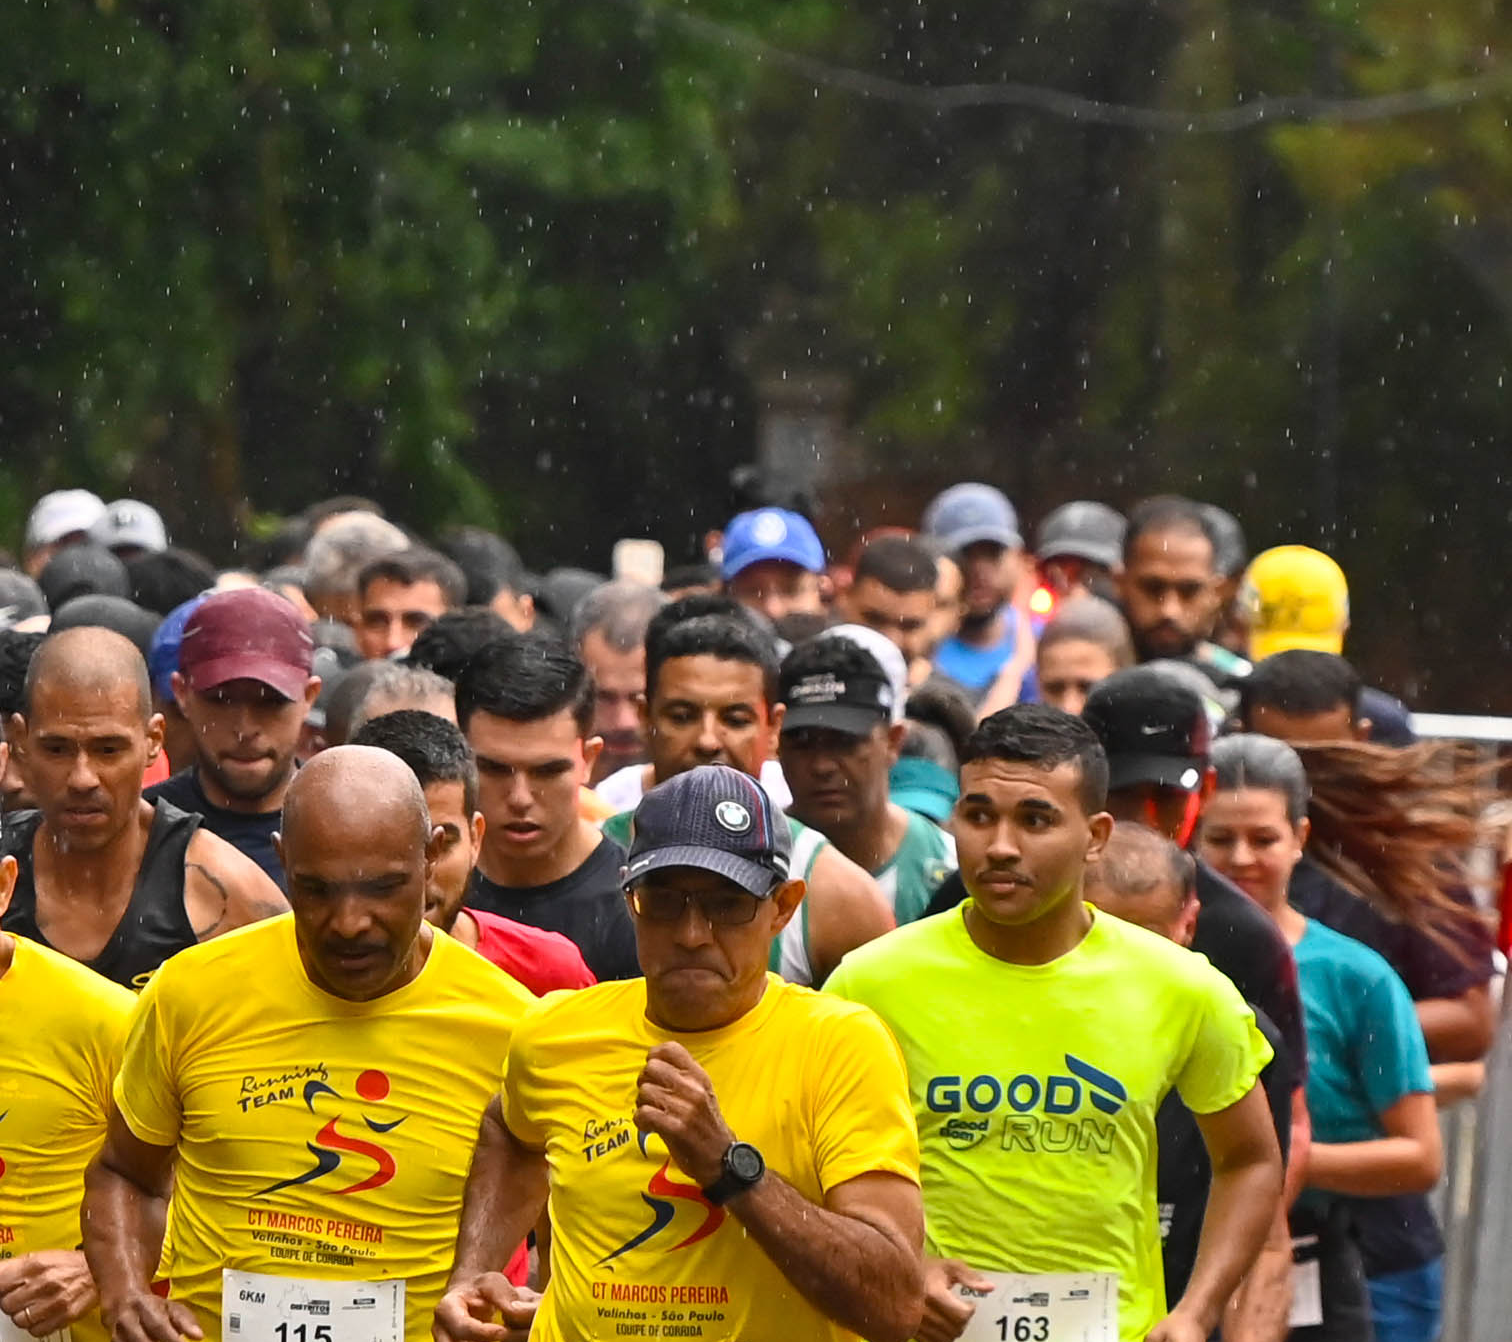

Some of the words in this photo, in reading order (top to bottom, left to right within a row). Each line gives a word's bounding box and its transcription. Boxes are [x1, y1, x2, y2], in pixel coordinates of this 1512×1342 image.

[240, 1062, 329, 1096] Running
[237, 1087, 294, 1113] TEAM
[927, 1074, 1082, 1114] GOOD
[947, 1118, 989, 1131] Good
[1000, 1114, 1117, 1154] RUN
[582, 1129, 631, 1163] TEAM
[248, 1209, 263, 1225] CT
[267, 1212, 322, 1235] MARCOS
[326, 1220, 383, 1244] PEREIRA
[252, 1230, 303, 1246] Valinhos
[315, 1240, 338, 1252] São
[342, 1244, 377, 1257] Paulo
[270, 1246, 301, 1261] EQUIPE
[303, 1250, 315, 1263] DE
[239, 1289, 265, 1304] 6KM
[592, 1282, 608, 1299] CT
[611, 1283, 666, 1303] MARCOS
[671, 1286, 729, 1304] PEREIRA
[597, 1307, 647, 1320] Valinhos
[661, 1310, 684, 1321] São
[688, 1311, 725, 1321] Paulo
[616, 1323, 646, 1336] EQUIPE
[995, 1315, 1050, 1342] 163
